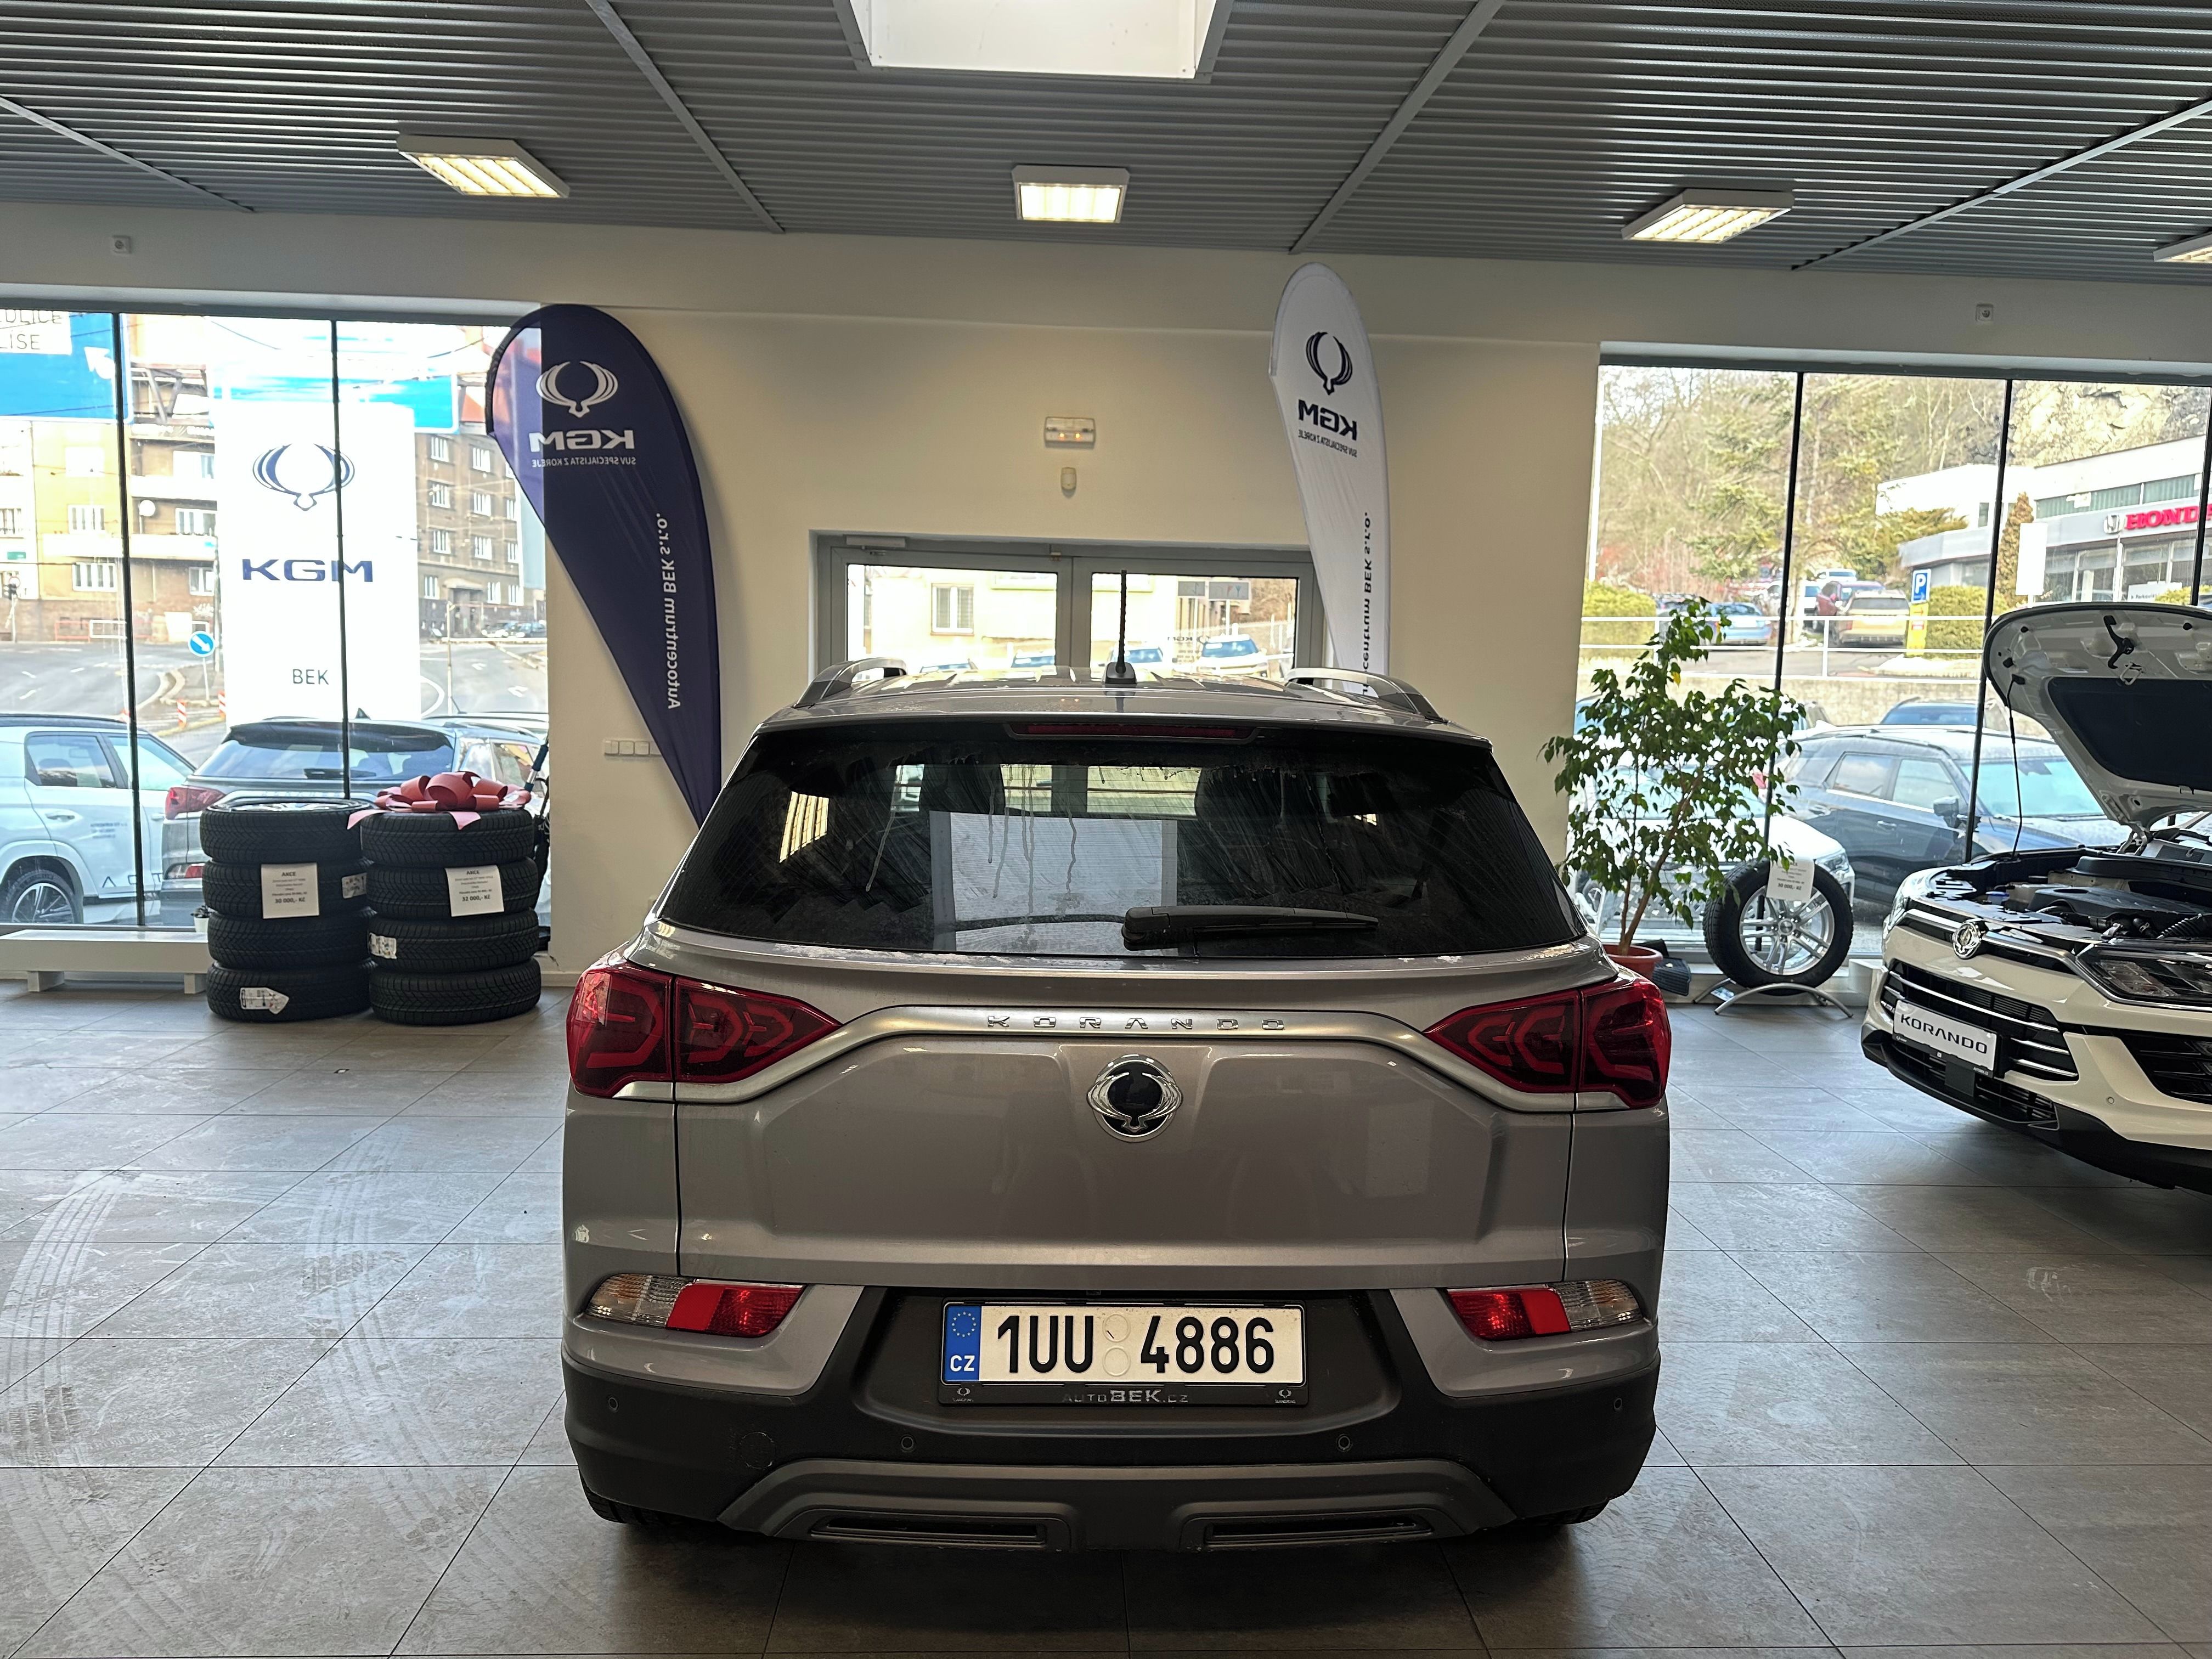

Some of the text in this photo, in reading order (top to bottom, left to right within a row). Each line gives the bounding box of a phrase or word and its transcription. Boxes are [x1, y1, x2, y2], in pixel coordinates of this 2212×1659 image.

[0, 309, 61, 324] DLICE
[242, 559, 373, 582] KGM
[1915, 574, 1926, 594] P
[292, 668, 329, 685] BEK
[988, 1015, 1285, 1030] KORANDO
[1900, 1014, 1988, 1054] KORANDO
[998, 1314, 1274, 1373] 1UU 4886
[950, 1355, 975, 1372] CZ
